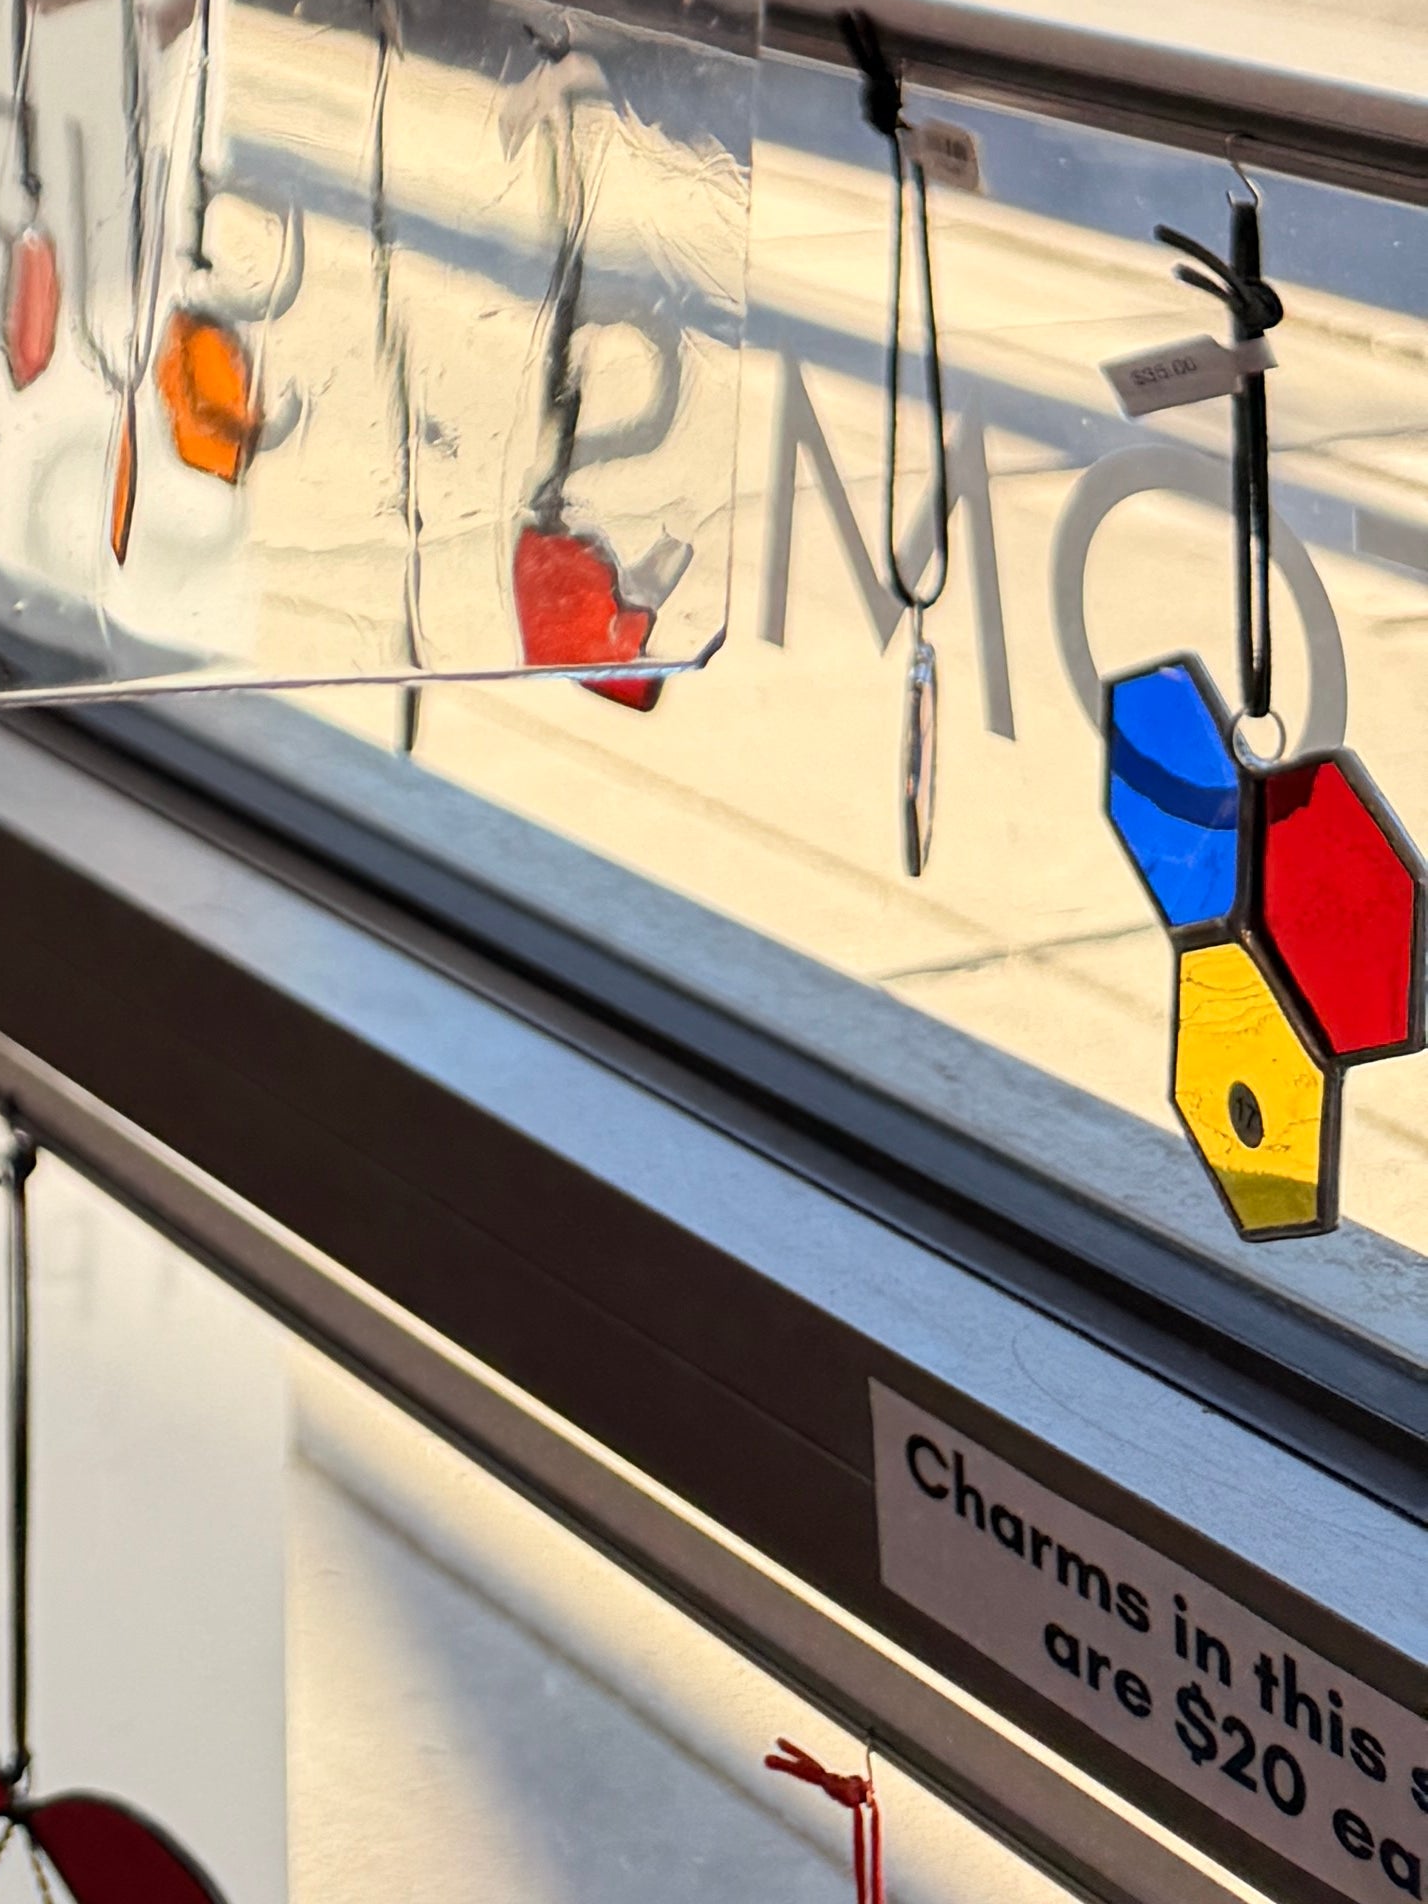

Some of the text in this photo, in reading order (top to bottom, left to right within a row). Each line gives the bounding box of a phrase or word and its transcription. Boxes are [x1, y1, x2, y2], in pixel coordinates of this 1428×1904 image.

[905, 1434, 1387, 1784] Charms in this
[1044, 1622, 1152, 1718] are
[1176, 1682, 1308, 1818] $20
